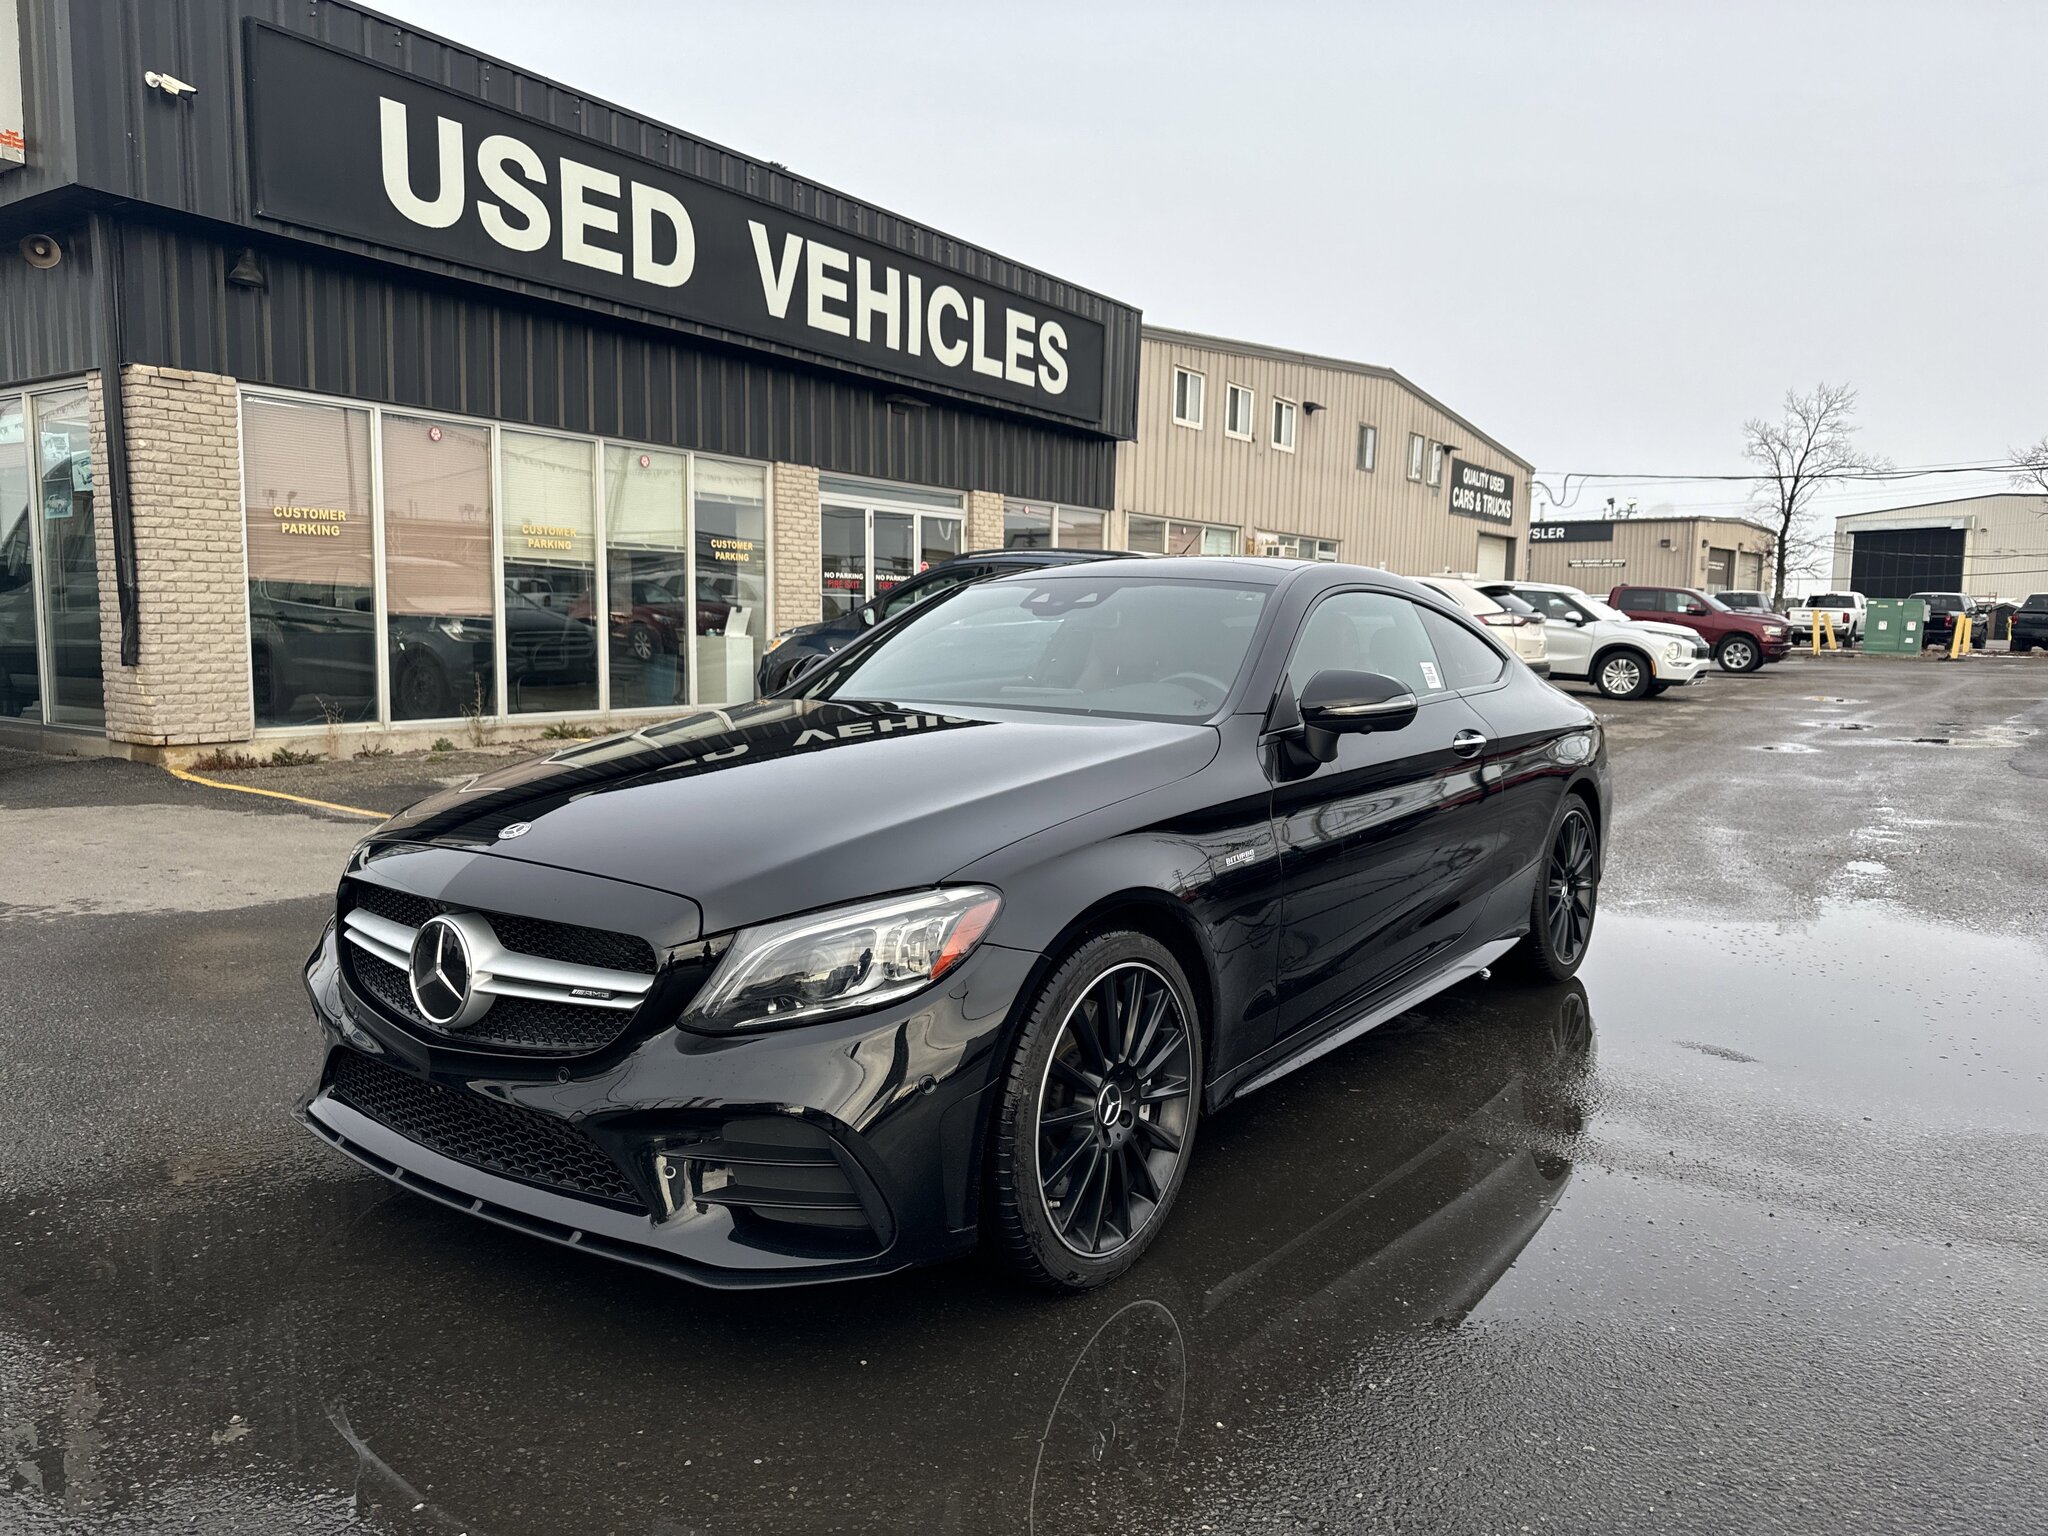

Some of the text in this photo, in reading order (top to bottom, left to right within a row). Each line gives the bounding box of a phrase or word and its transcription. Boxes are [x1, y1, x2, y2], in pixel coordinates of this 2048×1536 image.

[379, 96, 1068, 395] USED VEHICLES
[1462, 467, 1506, 494] QUALITY USED
[1452, 486, 1512, 519] CARS & TRUCKS
[273, 506, 347, 521] CUSTOMER
[281, 522, 341, 536] PARKING
[522, 524, 577, 538] CUSTOMER
[528, 537, 572, 550] PARKING
[710, 539, 753, 551] CUSTOMER
[715, 551, 749, 562] PARKING
[824, 571, 864, 580] NO PARKING
[827, 580, 861, 589] FIRE EXIT
[581, 990, 609, 999] AMG
